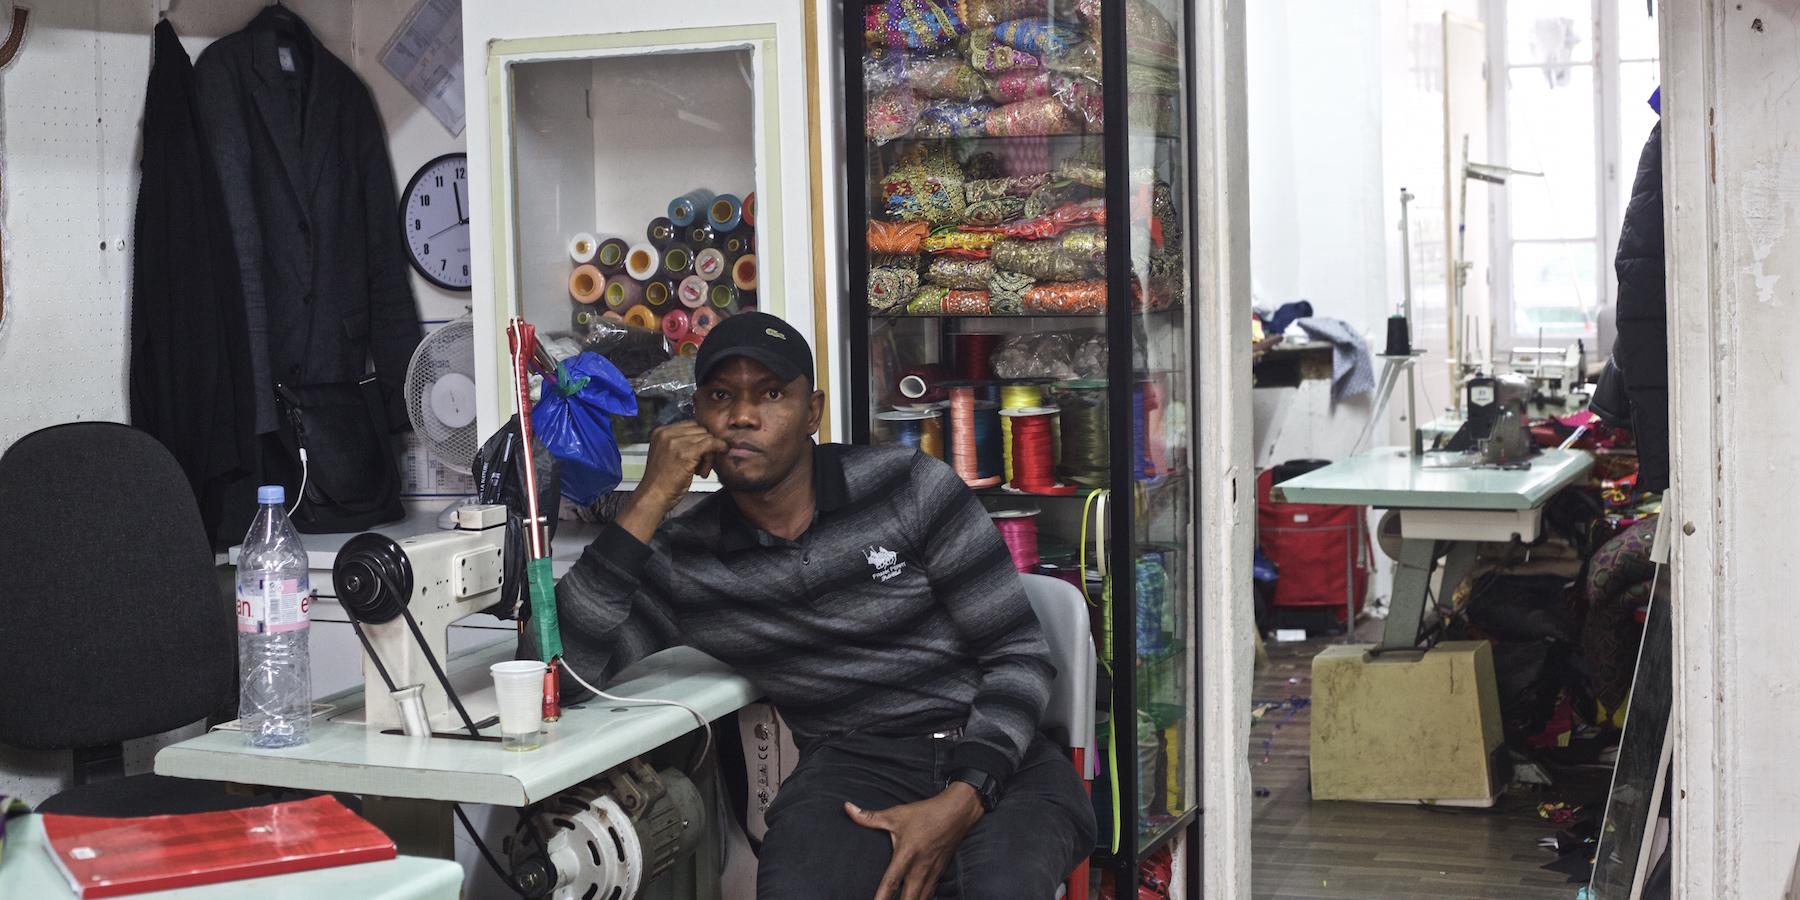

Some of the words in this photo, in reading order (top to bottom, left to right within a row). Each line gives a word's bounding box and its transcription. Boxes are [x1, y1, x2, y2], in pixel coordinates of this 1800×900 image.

[455, 167, 465, 179] 12
[435, 175, 443, 187] 11
[420, 194, 430, 206] 10
[415, 218, 421, 231] 9
[424, 243, 429, 255] 8
[441, 259, 446, 271] 7
[462, 264, 468, 276] 6
